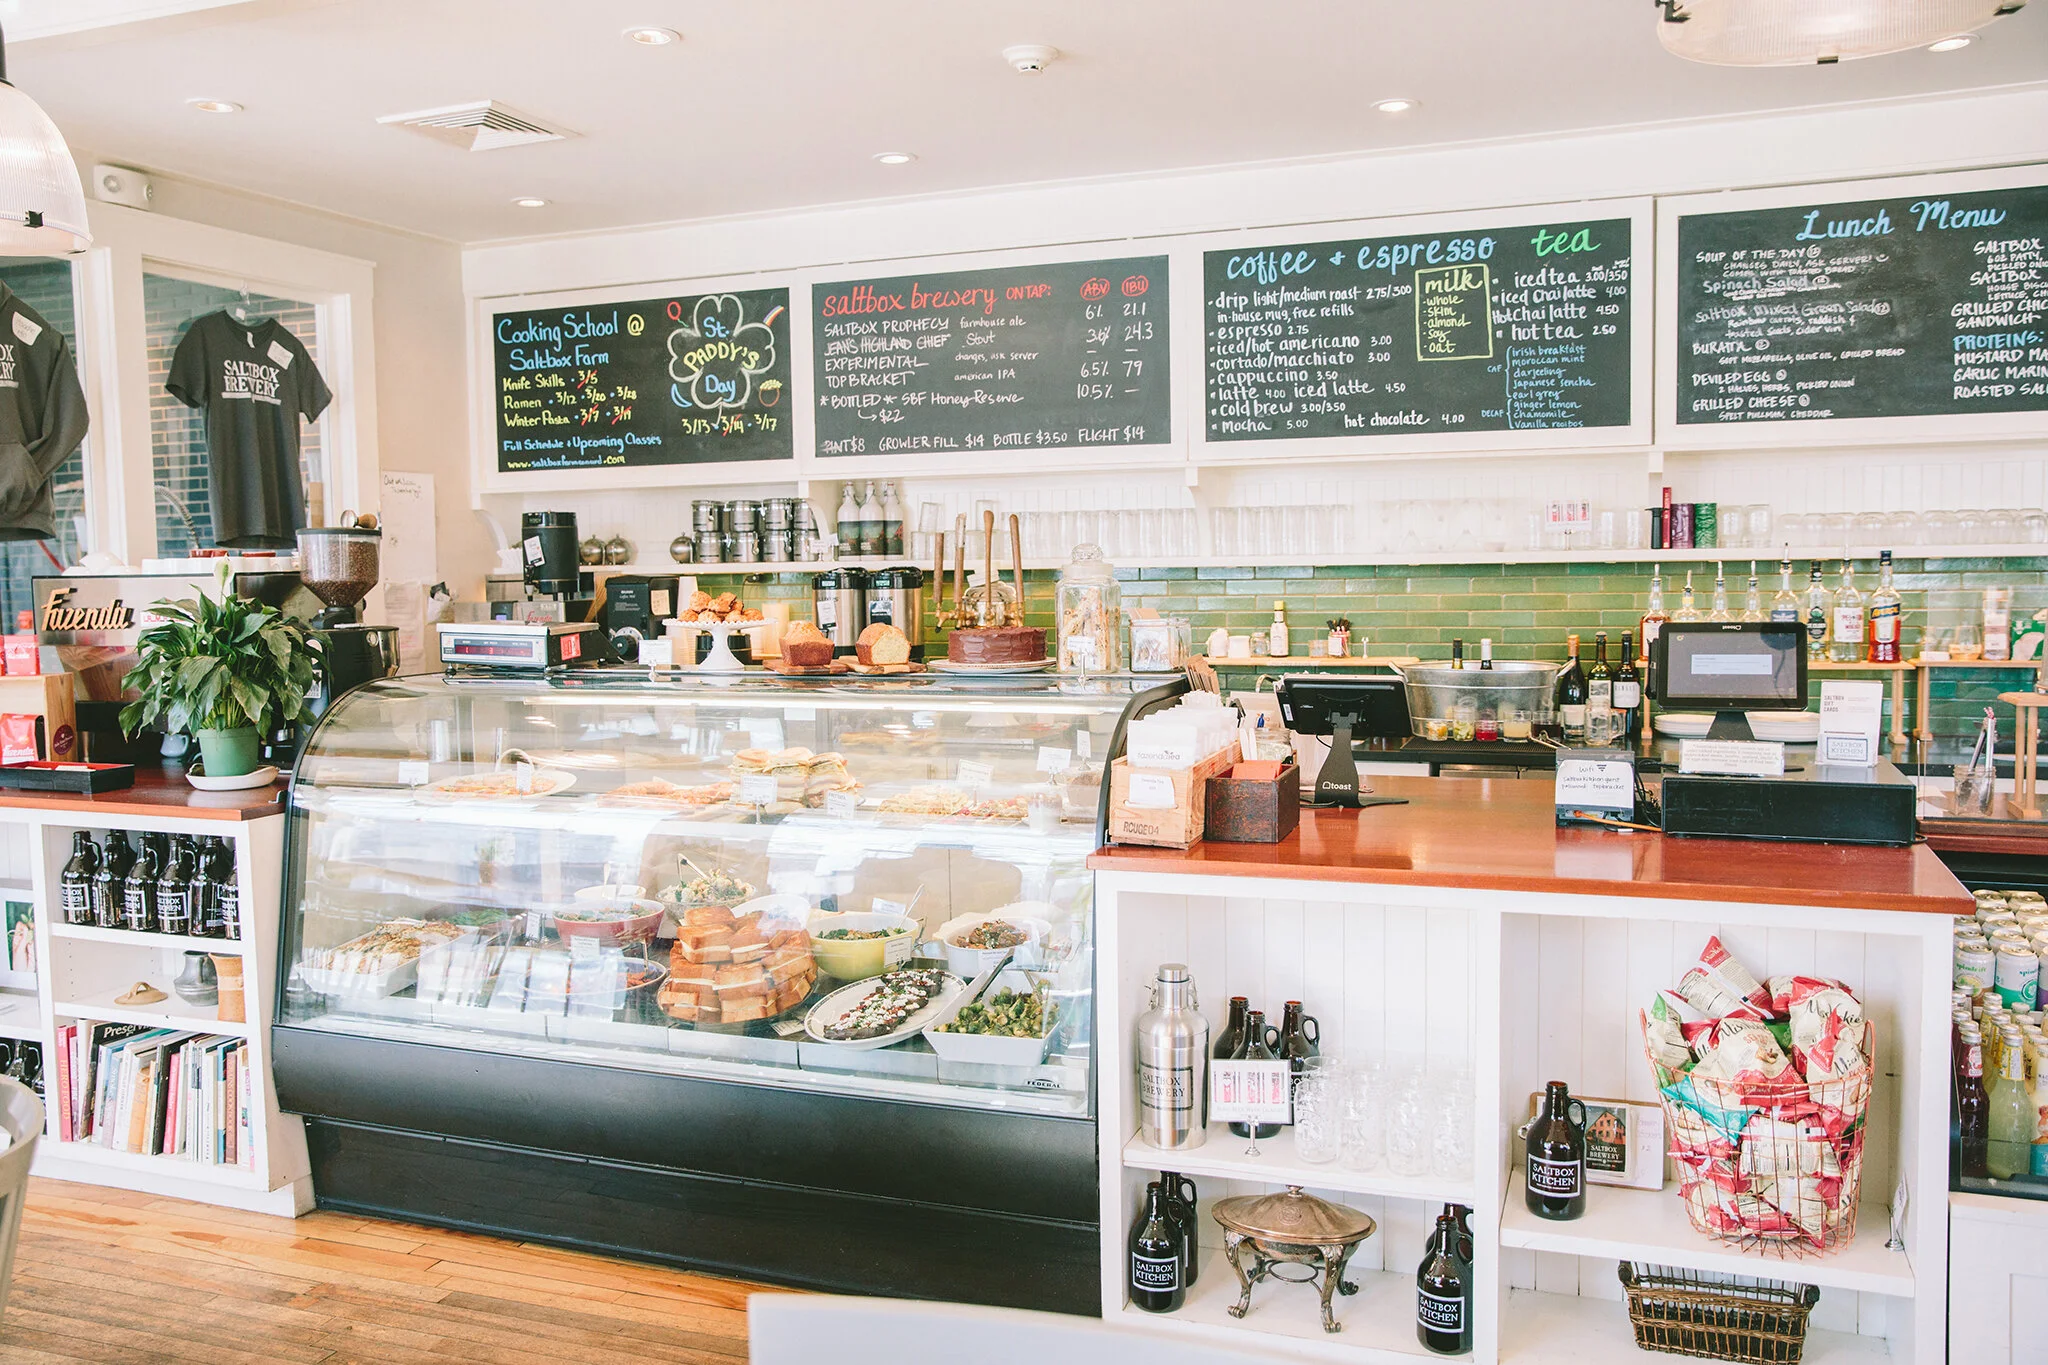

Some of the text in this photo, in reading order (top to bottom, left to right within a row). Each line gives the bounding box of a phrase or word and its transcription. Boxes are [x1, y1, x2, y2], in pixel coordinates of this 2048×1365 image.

[1795, 200, 2006, 241] Lunch Menu
[1531, 228, 1601, 257] tea
[1973, 238, 2045, 255] SALTBOX
[1226, 236, 1497, 285] coffee espresso
[1696, 247, 1806, 263] SOUP OF THE DAY
[1425, 269, 1483, 294] milk
[1514, 267, 1581, 289] iced tea
[1702, 277, 1762, 294] Spinach
[1766, 275, 1808, 289] Salad
[1970, 269, 2041, 286] SALTBOX
[1501, 284, 1597, 307] iced latte
[1987, 283, 2019, 293] HOUSE
[822, 282, 998, 317] saltbox brewery
[1216, 292, 1249, 312] drip
[1253, 286, 1327, 308] light/medium
[1329, 286, 1362, 301] roast
[1427, 295, 1464, 306] whole
[1293, 304, 1354, 318] free refills
[1428, 306, 1457, 317] skim
[1549, 302, 1588, 322] latte
[1802, 302, 1845, 316] Green
[1950, 300, 2014, 317] GRILLED
[703, 316, 729, 338] St.
[824, 302, 1147, 337] SALTBOX PROPHECY farmhouse ale 21.1
[1427, 313, 1472, 328] almond
[1955, 312, 2042, 330] SANDWICH
[498, 310, 645, 352] Cooking School @
[966, 321, 1153, 346] Stout 24.3
[1218, 324, 1309, 340] espresso 2.75
[1428, 329, 1451, 343] soy
[1511, 323, 1541, 341] hot
[1542, 323, 1584, 339] tea
[1217, 335, 1392, 356] iced/hot americano 3.00
[1428, 341, 1456, 353] oat
[1953, 330, 2045, 351] PROTEINS:
[509, 344, 609, 371] Saltbox Farm
[683, 341, 760, 373] PADDY'S
[824, 351, 1039, 373] EXPERIMENTAL server
[1216, 351, 1391, 371] cortado/macchiato 3.00
[1512, 355, 1585, 367] moroccan mint
[1954, 349, 2024, 366] MUSTARD
[223, 359, 280, 383] SALTBOX
[848, 360, 1143, 387] BRACKET american IPA 79
[1218, 370, 1339, 386] cappuccino 3.50
[1513, 368, 1567, 379] darjeeling
[1692, 373, 1742, 386] DEVILED
[1744, 371, 1771, 382] EGG
[1953, 367, 2000, 382] GARLIC
[503, 373, 565, 392] Knife Skills
[705, 374, 736, 402] Day
[1219, 386, 1259, 401] latte
[1294, 382, 1328, 398] iced
[1333, 379, 1375, 396] latte
[1385, 383, 1406, 393] 4.50
[1512, 376, 1597, 390] japanese sencha
[504, 390, 577, 409] Ramen 3/12
[902, 391, 927, 406] SBF
[1512, 390, 1565, 401] earl grey
[1953, 384, 2015, 400] ROASTED
[1220, 400, 1293, 418] cold brew
[1514, 400, 1582, 411] ginger lemon
[1692, 395, 1798, 411] GRILLED CHEESE
[504, 410, 570, 427] Winter Pasta
[879, 408, 905, 424] $22
[1344, 409, 1465, 428] hot chocolate 4.00
[1481, 410, 1505, 418] DECAF
[1513, 410, 1576, 419] chamomile
[682, 413, 777, 435] 3/13 3/17
[1222, 419, 1309, 433] mocha 5.00
[503, 432, 662, 455] Full Schedule Upcoming Classes
[879, 425, 1145, 452] GROWLER FILL $14 BOTTLE $3.50 FLIGHT $14
[41, 587, 129, 632] Fazenda
[1330, 782, 1352, 790] toast
[1027, 1080, 1061, 1088] FEDERAL
[1142, 1072, 1181, 1087] SALTBOX
[1142, 1084, 1186, 1098] BREWERY
[1589, 1152, 1620, 1160] BREWERY
[1591, 1145, 1618, 1153] SALTBOX
[1532, 1163, 1575, 1177] SALTBOX
[1532, 1172, 1576, 1186] KITCHEN
[1136, 1261, 1173, 1272] SALTBOX
[1136, 1269, 1174, 1281] KITCHEN
[1419, 1296, 1458, 1312] SALTBOX
[1419, 1304, 1459, 1321] KITCHEN
